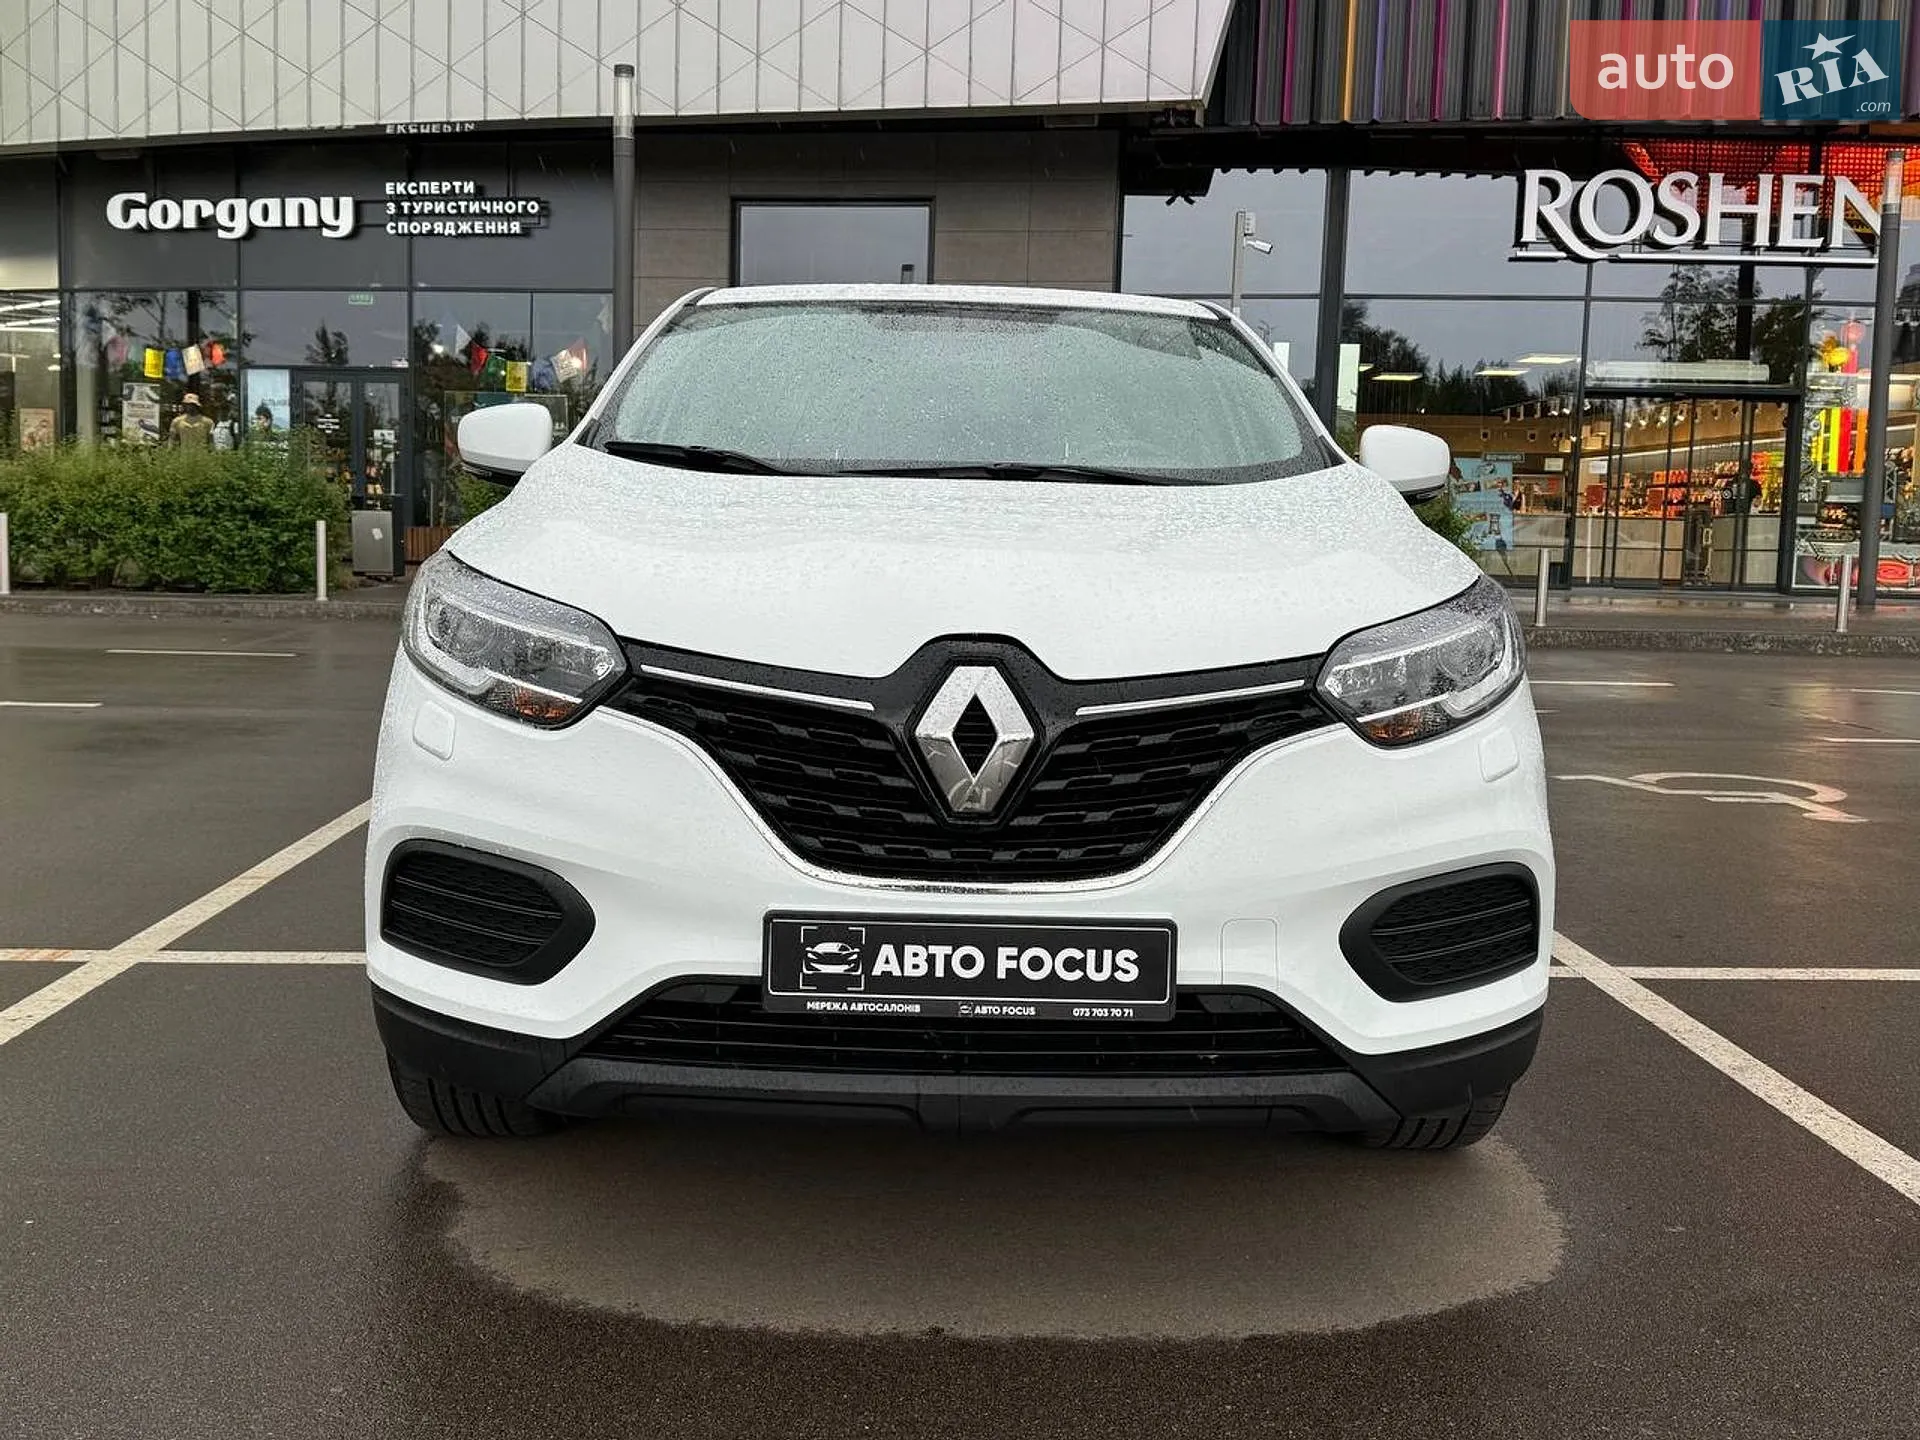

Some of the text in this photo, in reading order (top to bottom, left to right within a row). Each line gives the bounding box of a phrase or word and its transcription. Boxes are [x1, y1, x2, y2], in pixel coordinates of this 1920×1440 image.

[385, 181, 475, 195] ЕКСПЕРТИ
[106, 191, 355, 239] Gorgany
[400, 201, 540, 215] ТУРИСТИЧНОГО
[1519, 169, 1882, 259] ROSHEN
[386, 221, 521, 236] СПОРЯДЖЕННЯ
[871, 943, 1140, 983] АВТО FOCUS
[806, 1001, 921, 1013] МЕРЕЖА АВТОСАЛОНІВ
[1002, 1006, 1036, 1016] FOCUS
[1072, 1007, 1134, 1017] 073 703 70 71
